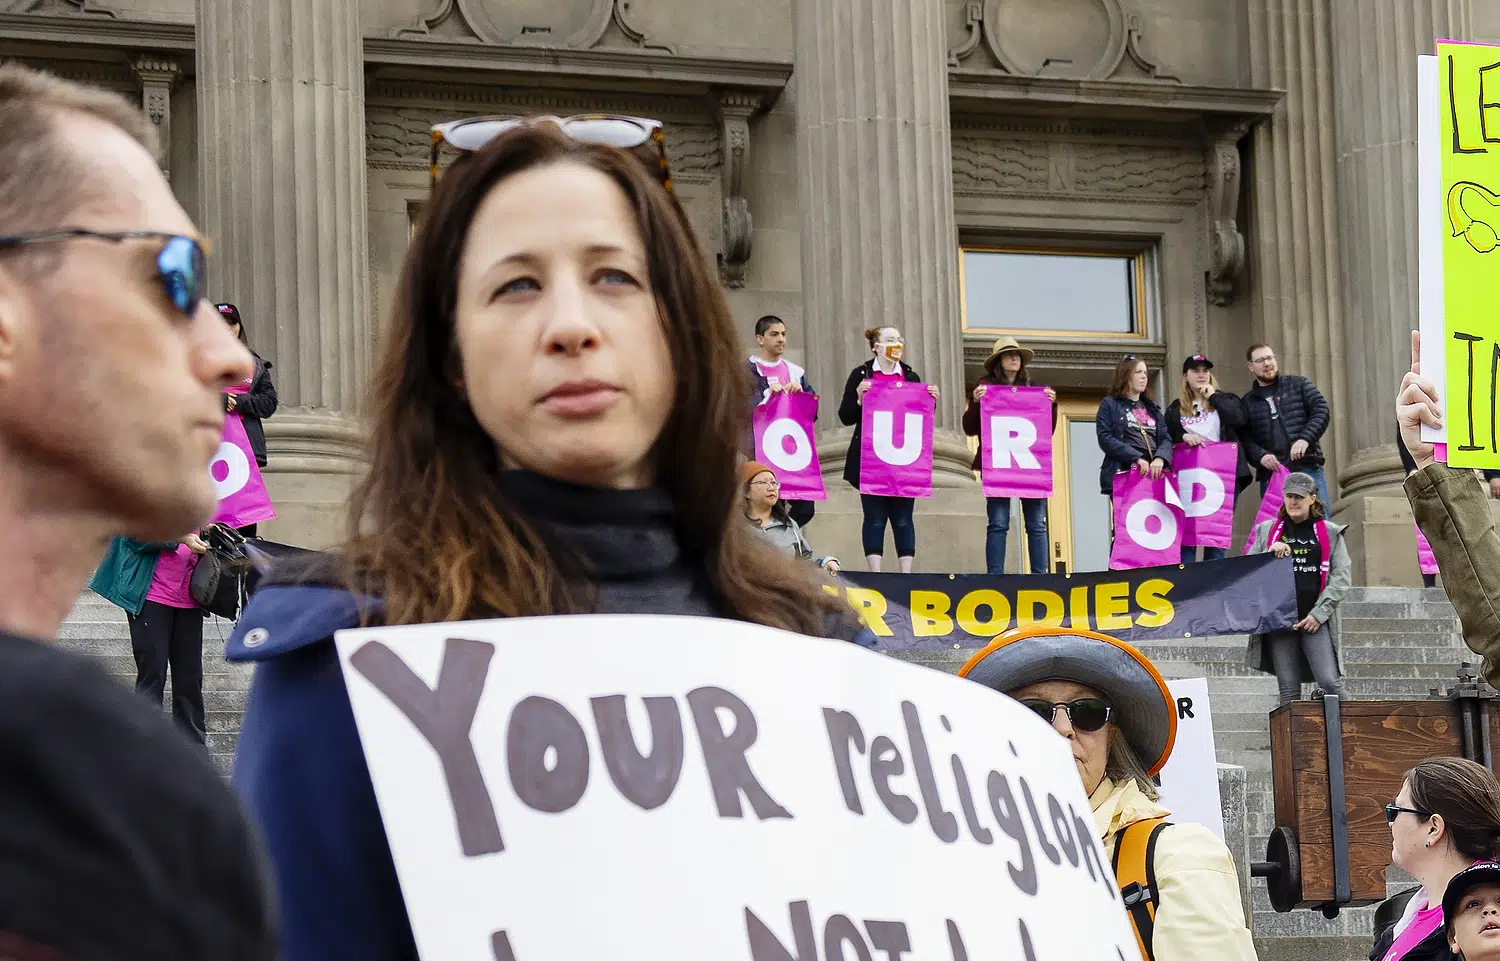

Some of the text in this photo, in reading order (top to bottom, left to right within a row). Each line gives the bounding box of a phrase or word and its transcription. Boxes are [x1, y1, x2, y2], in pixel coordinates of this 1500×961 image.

[909, 578, 1176, 638] BODIES
[349, 637, 1116, 899] YOUR religion
